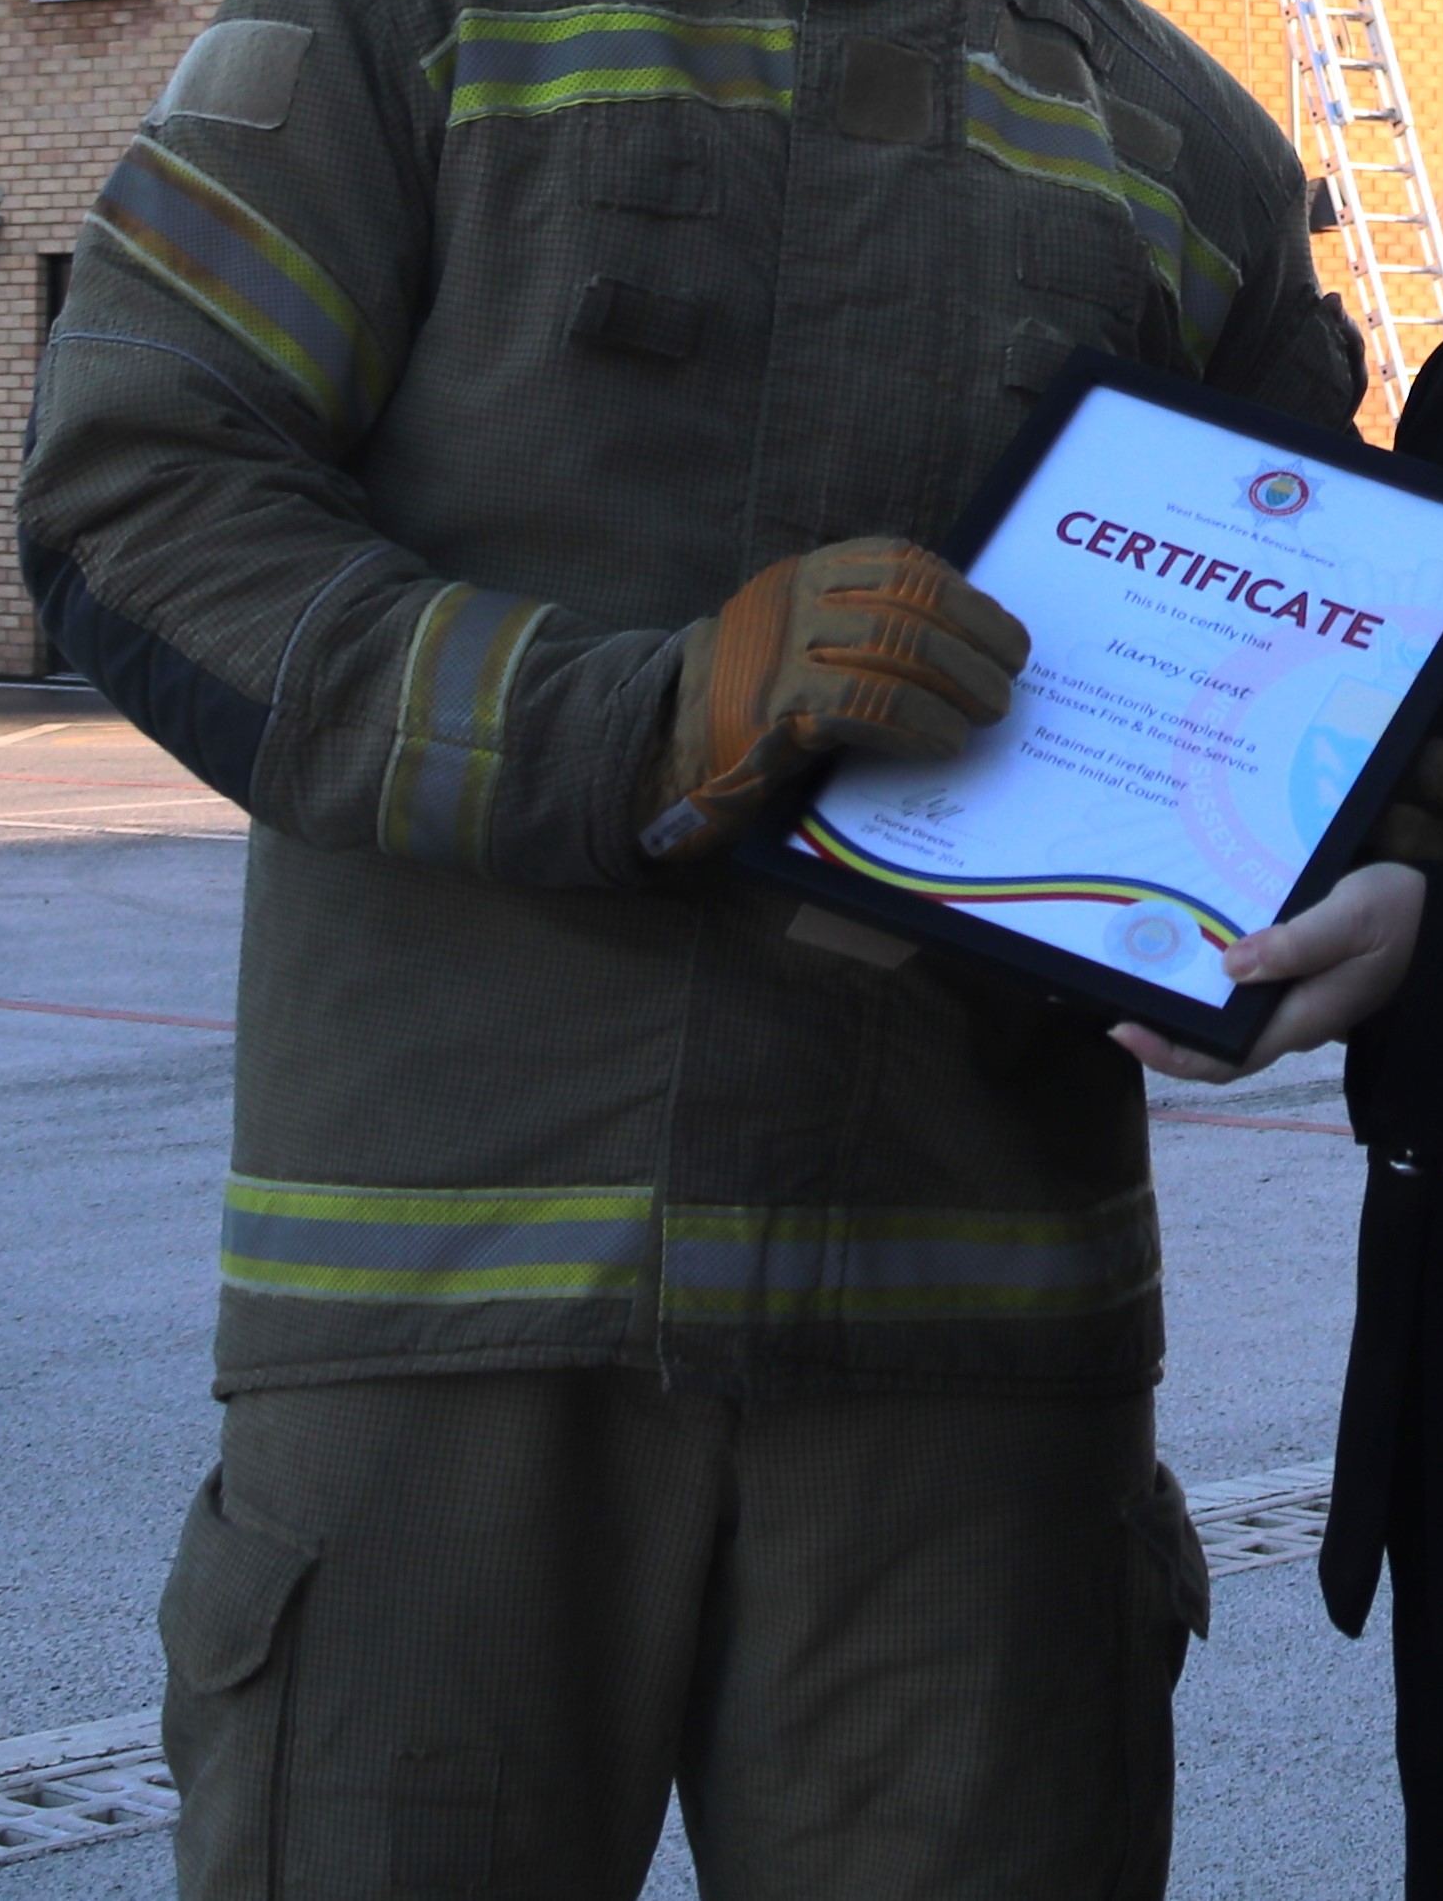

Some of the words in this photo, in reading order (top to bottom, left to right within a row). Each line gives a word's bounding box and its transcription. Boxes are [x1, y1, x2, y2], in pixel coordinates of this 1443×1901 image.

[1166, 502, 1193, 517] West
[1195, 511, 1227, 530] Sussex
[1228, 521, 1249, 537] Fire
[1261, 535, 1297, 554] Rescue
[1300, 547, 1336, 568] Service
[1056, 509, 1385, 650] CERTIFICATE
[1124, 589, 1154, 610] This
[1156, 600, 1167, 615] is
[1170, 606, 1187, 621] to
[1190, 615, 1240, 641] certify
[1241, 632, 1273, 652] that
[1105, 638, 1187, 678] Harvey
[1189, 669, 1256, 701] Guest
[1030, 661, 1058, 682] has
[1060, 672, 1158, 719] satisfactorily
[1160, 711, 1246, 749] completed
[1246, 742, 1257, 754] a
[1046, 689, 1097, 718] Sussex
[1099, 707, 1130, 728] Fire
[1130, 720, 1144, 734] &
[1146, 725, 1202, 755] Rescue
[1202, 746, 1260, 776] Service
[1019, 741, 1077, 773] Trainee
[1078, 759, 1124, 789] Initial
[1124, 781, 1180, 809] Course
[1034, 724, 1106, 761] Retained
[1107, 751, 1189, 792] Firefighter
[873, 812, 910, 833] Course
[911, 827, 955, 850] Director
[882, 830, 936, 858] November
